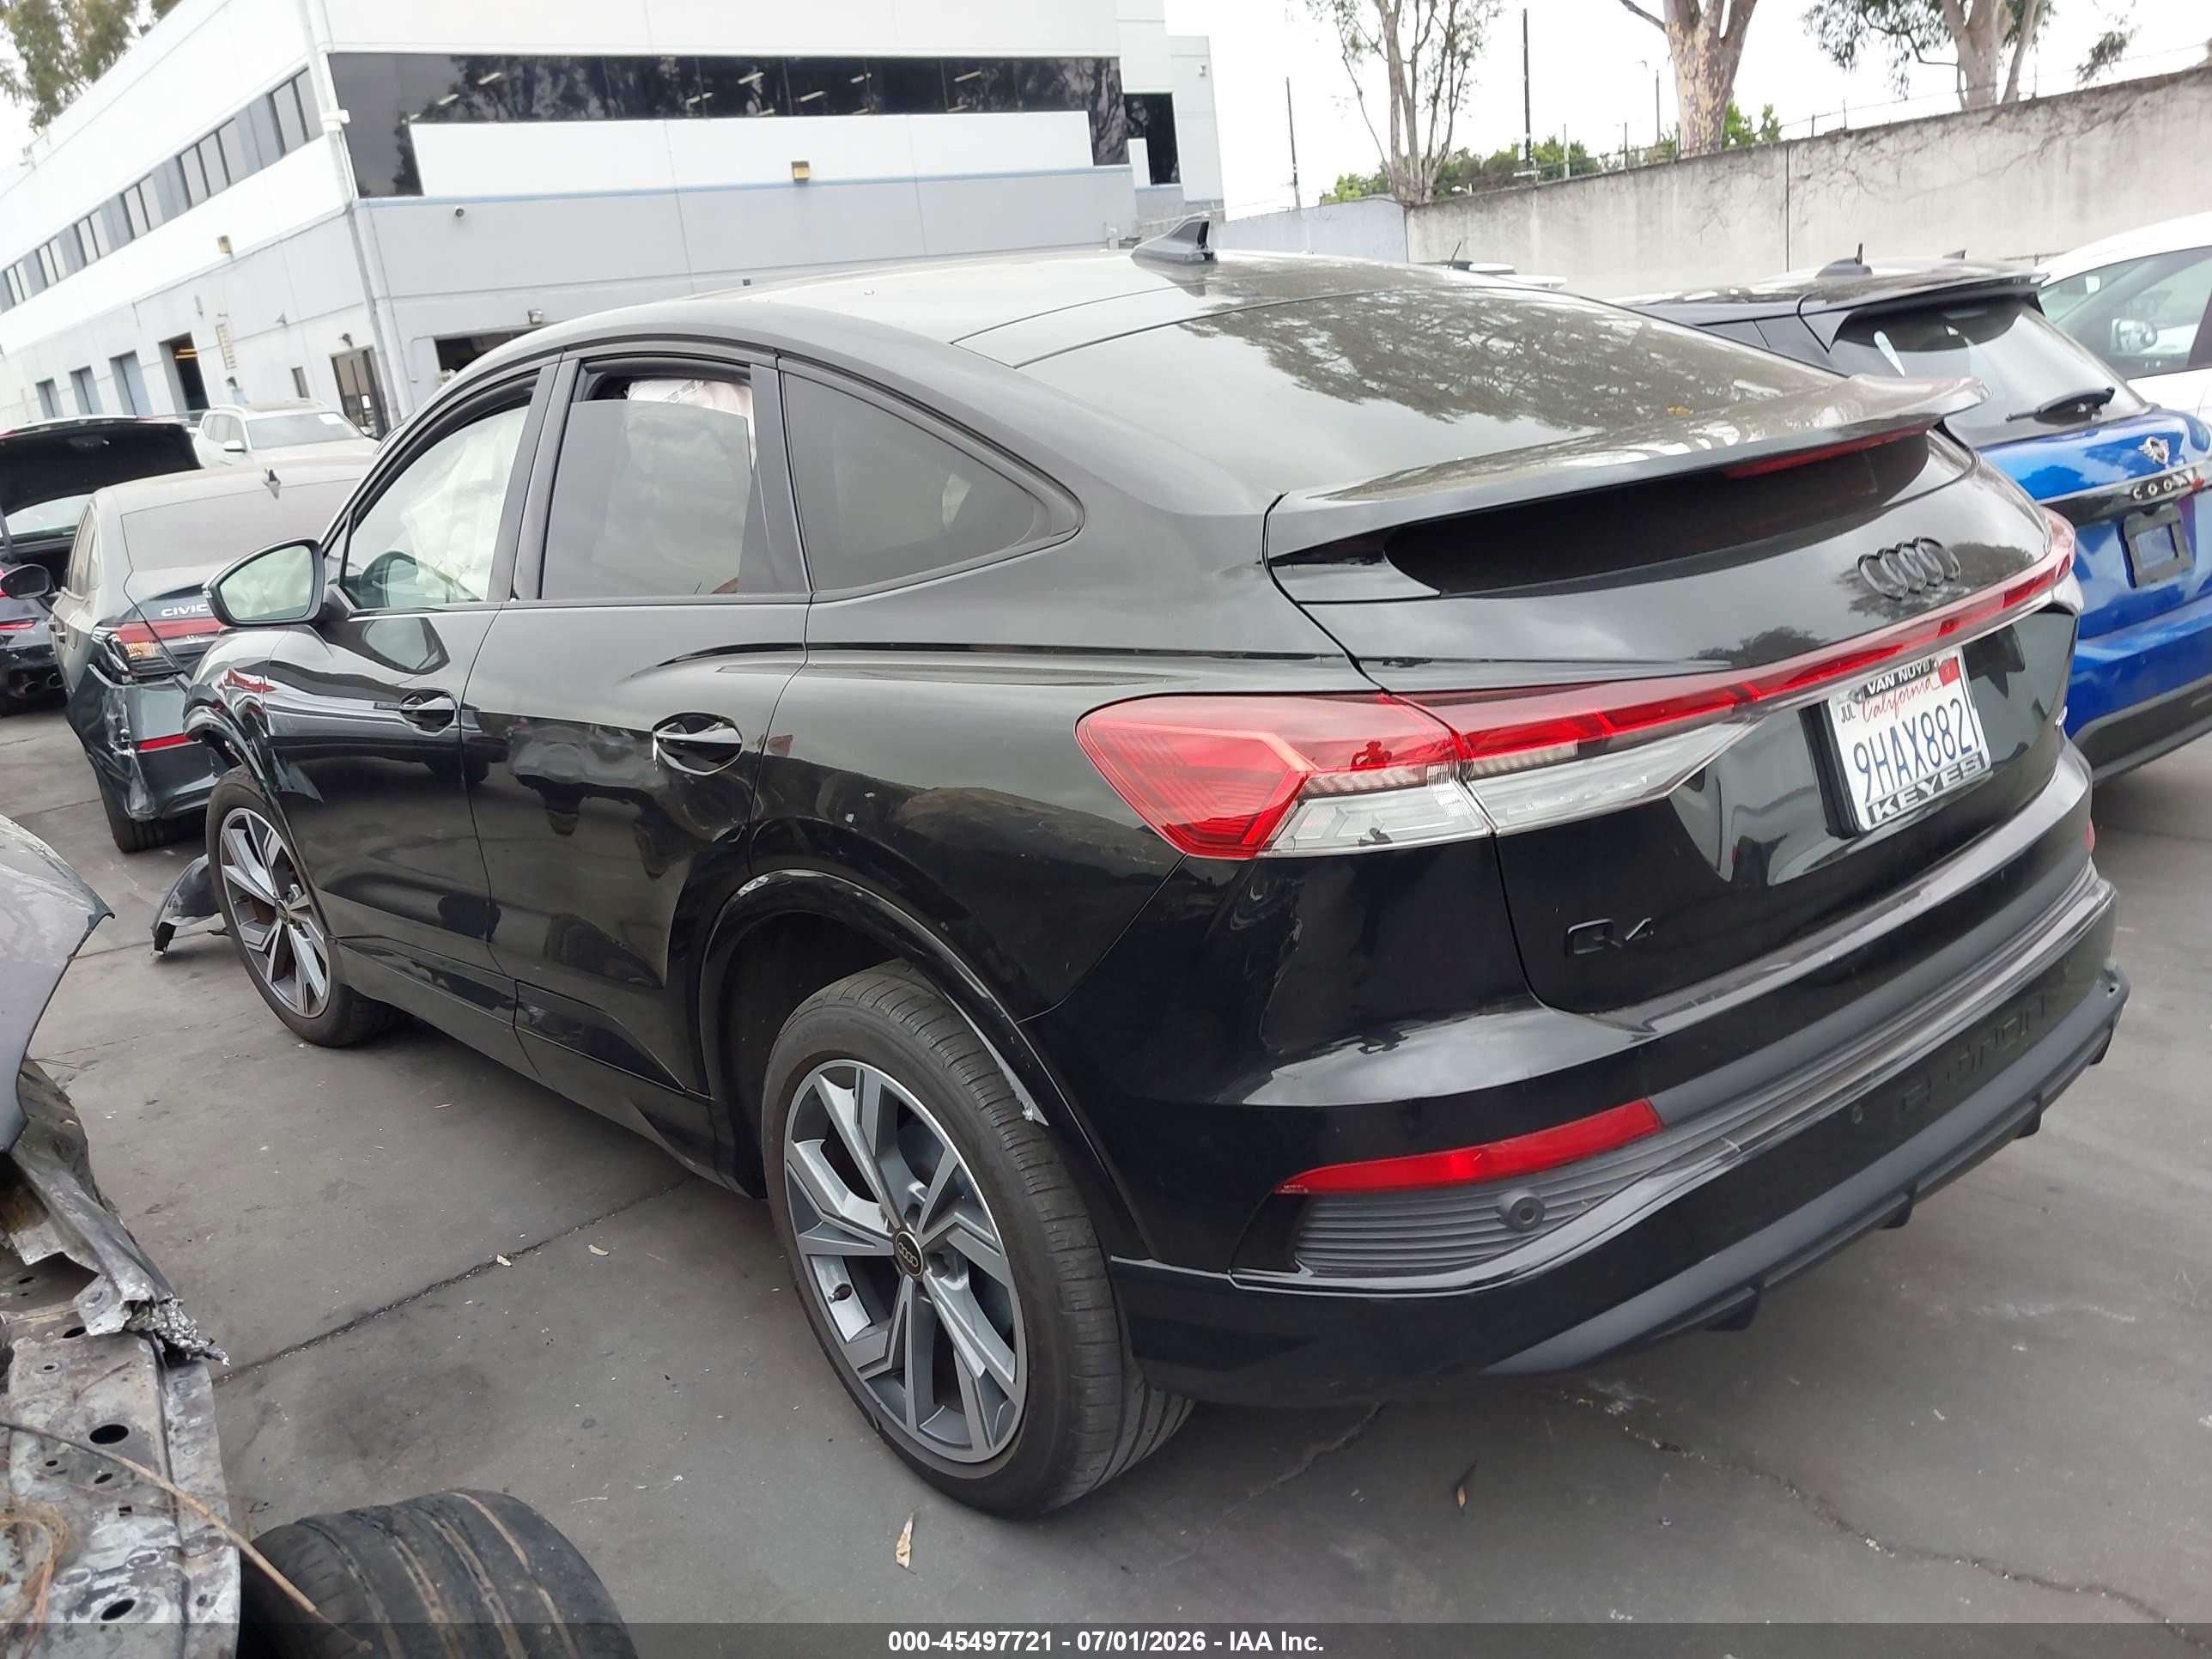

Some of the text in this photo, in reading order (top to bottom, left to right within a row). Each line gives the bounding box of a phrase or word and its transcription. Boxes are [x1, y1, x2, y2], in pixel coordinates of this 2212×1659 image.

[161, 603, 208, 617] CIVIC
[1862, 677, 1941, 723] California
[1867, 672, 1896, 696] VAN
[1841, 702, 1856, 723] JUL
[1852, 697, 1972, 802] 9HAX882
[1871, 754, 1983, 823] KEYES
[1565, 917, 1654, 957] Q4
